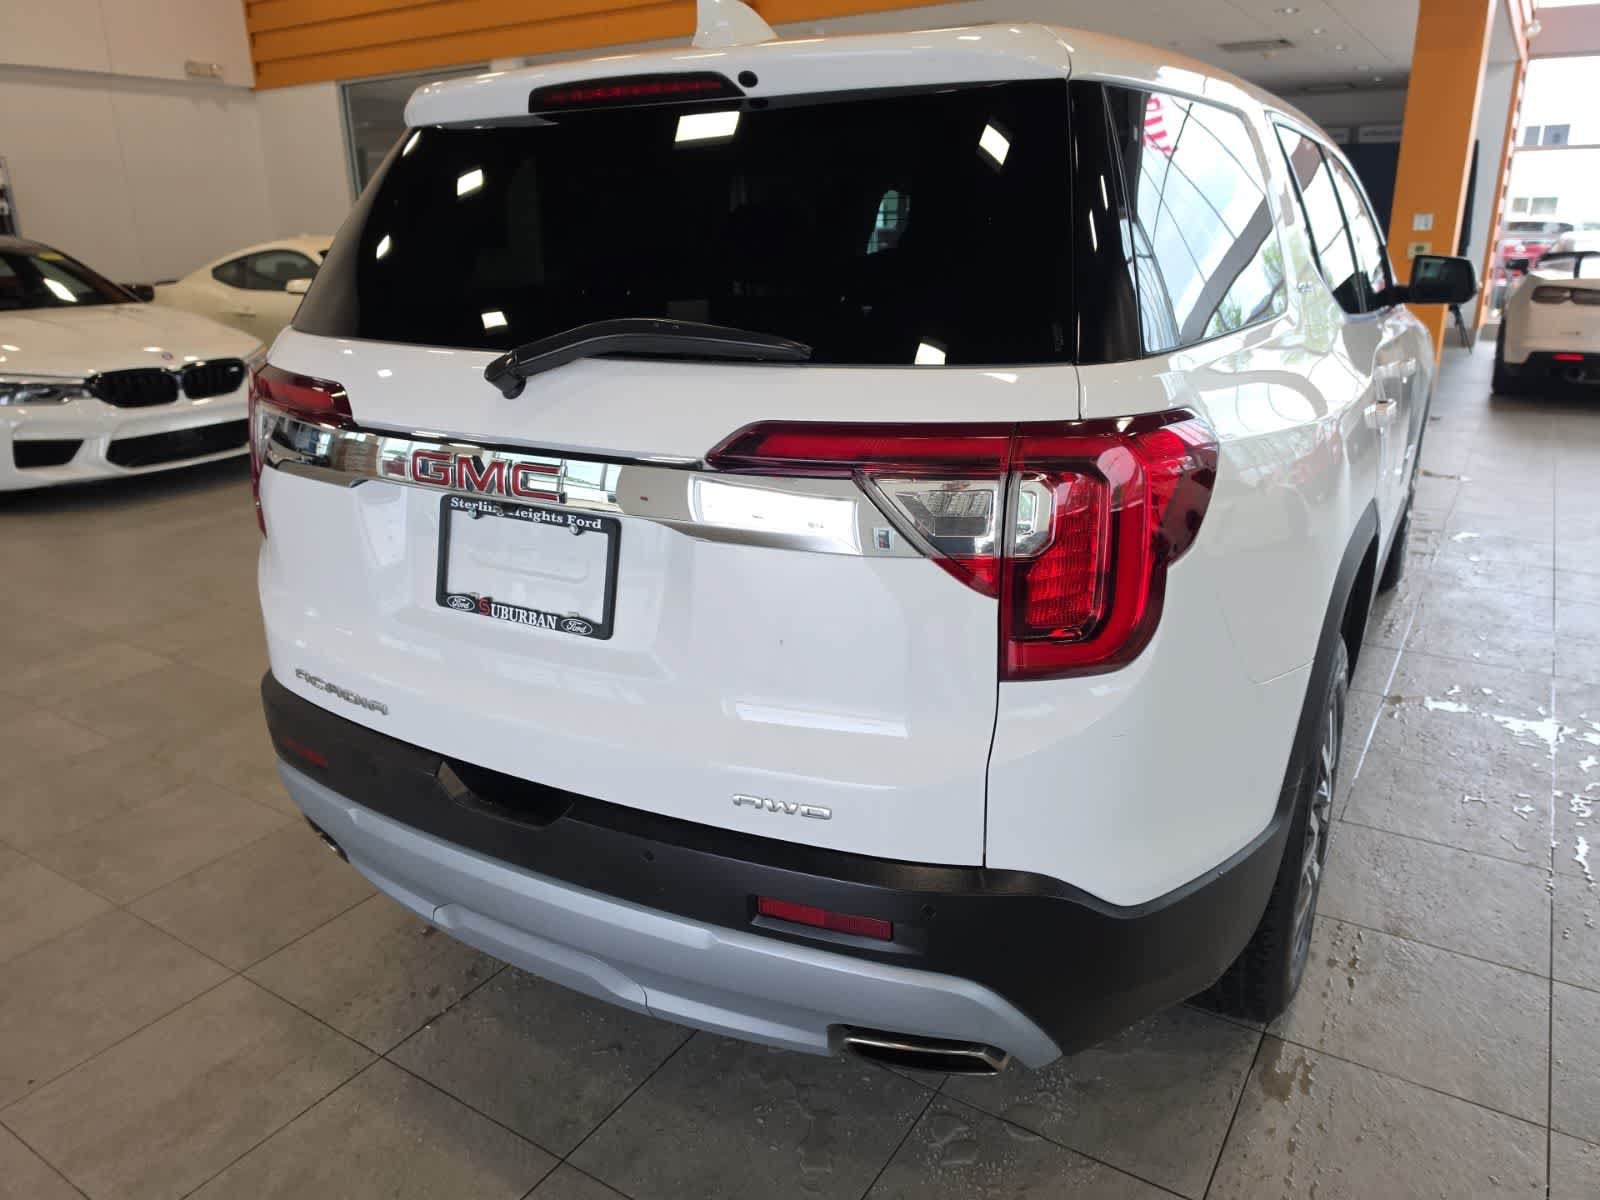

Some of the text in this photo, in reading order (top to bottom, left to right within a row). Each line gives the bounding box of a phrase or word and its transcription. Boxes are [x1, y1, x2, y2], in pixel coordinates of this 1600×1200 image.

[411, 448, 564, 502] GMC
[567, 514, 602, 530] Ford
[450, 596, 588, 634] Ford SUBURBAN Ford
[732, 793, 833, 820] AWD
